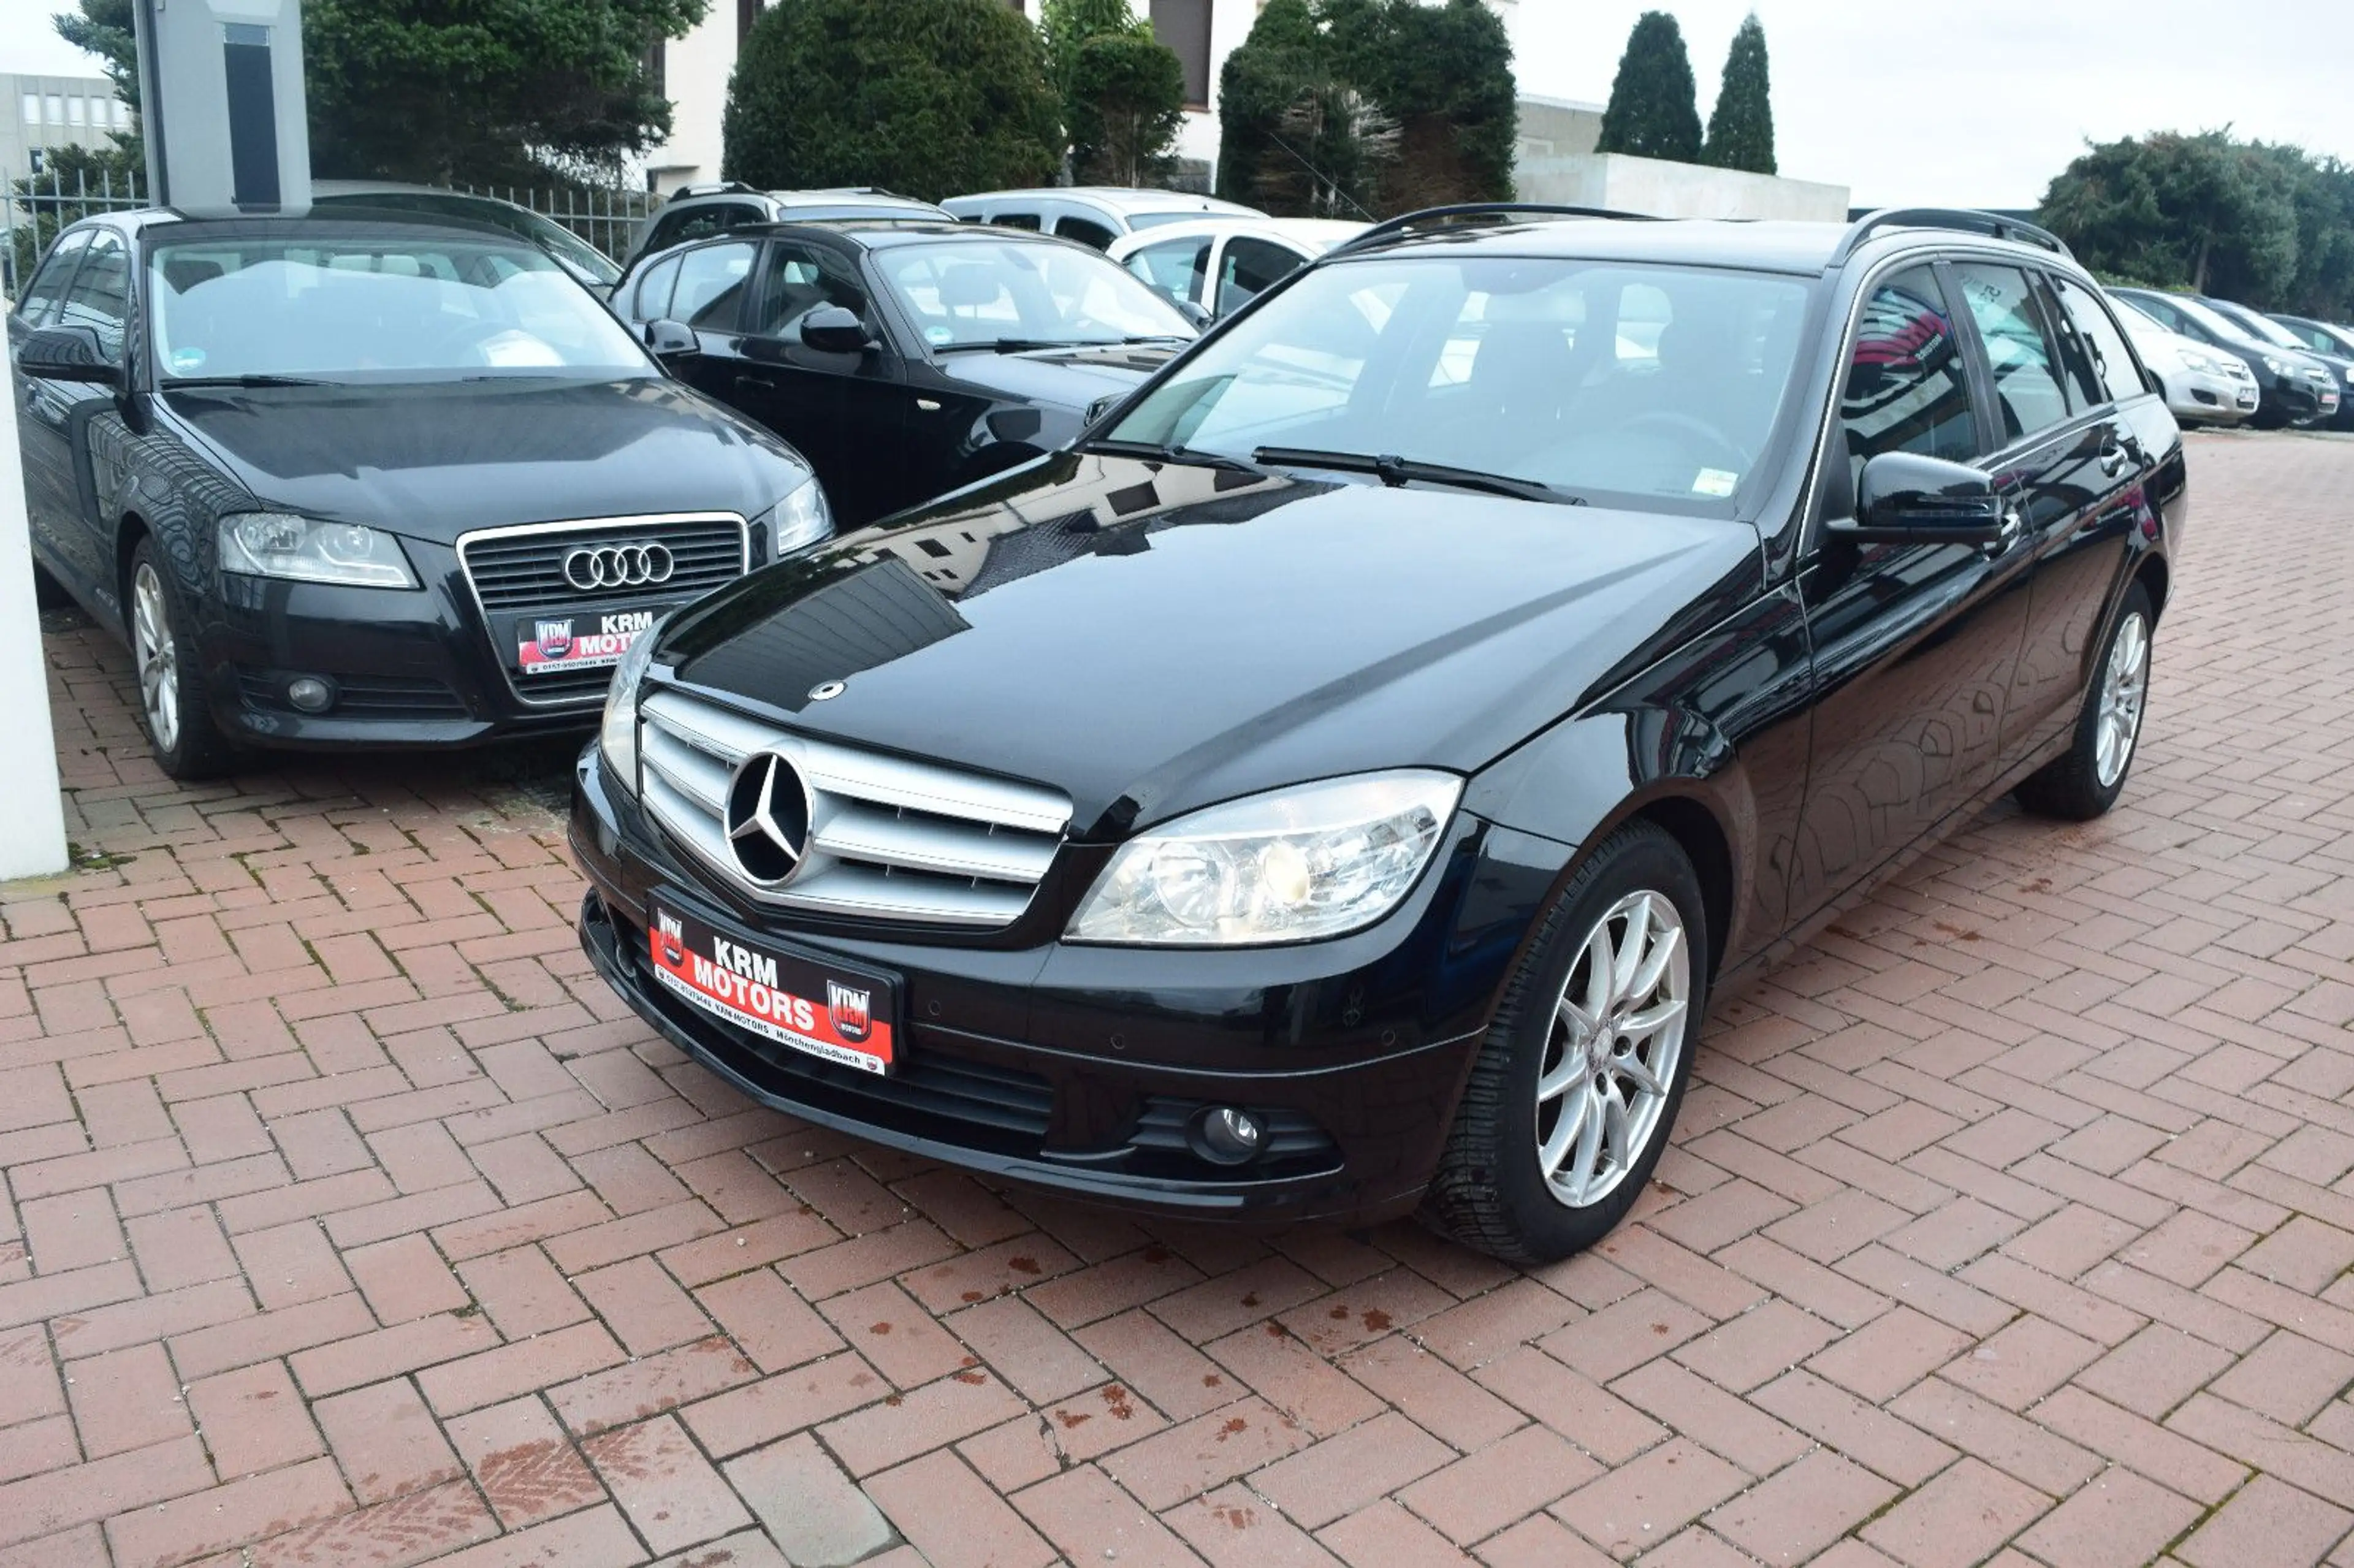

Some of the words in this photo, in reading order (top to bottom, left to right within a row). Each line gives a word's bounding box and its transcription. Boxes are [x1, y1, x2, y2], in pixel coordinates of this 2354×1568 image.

[601, 612, 652, 634] KRM
[714, 935, 778, 989] KRM
[693, 953, 815, 1031] MOTORS
